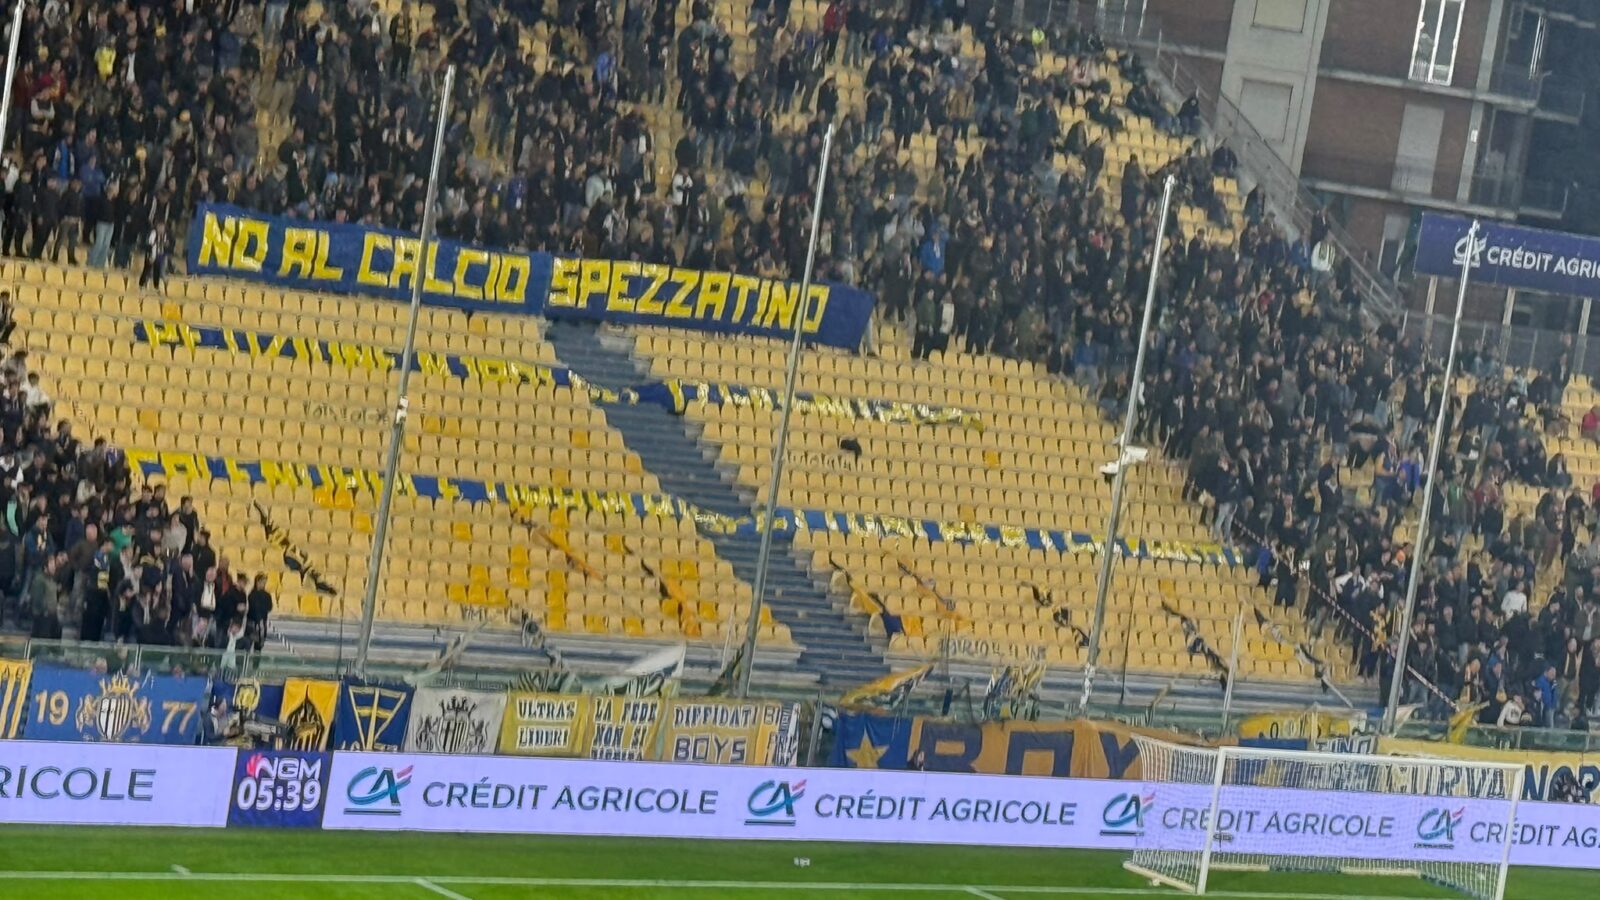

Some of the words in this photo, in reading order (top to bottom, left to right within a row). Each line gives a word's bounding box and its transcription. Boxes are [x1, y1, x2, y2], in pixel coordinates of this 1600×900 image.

[198, 212, 269, 272] NO
[278, 228, 343, 281] AL
[357, 232, 531, 303] CALCIO
[549, 257, 830, 333] SPEZZATINO
[1487, 245, 1553, 272] CRÉDIT
[36, 690, 69, 725] 19
[162, 702, 197, 735] 77
[518, 699, 577, 719] ULTRAS
[595, 699, 612, 721] LA
[674, 705, 760, 729] DIFFIDATI
[593, 724, 625, 748] NON
[673, 735, 748, 764] BOYS
[255, 757, 322, 780] NGM
[237, 777, 322, 811] 05:39
[423, 777, 547, 811] CRÉDIT
[552, 784, 719, 815] AGRICOLE
[815, 789, 925, 820] CRÉDIT
[929, 797, 1077, 826] AGRICOLE
[1162, 802, 1260, 833] CRÉDIT
[1264, 811, 1395, 838] AGRICOLE
[1470, 817, 1561, 847] CRÉDIT
[1562, 826, 1600, 849] AG
